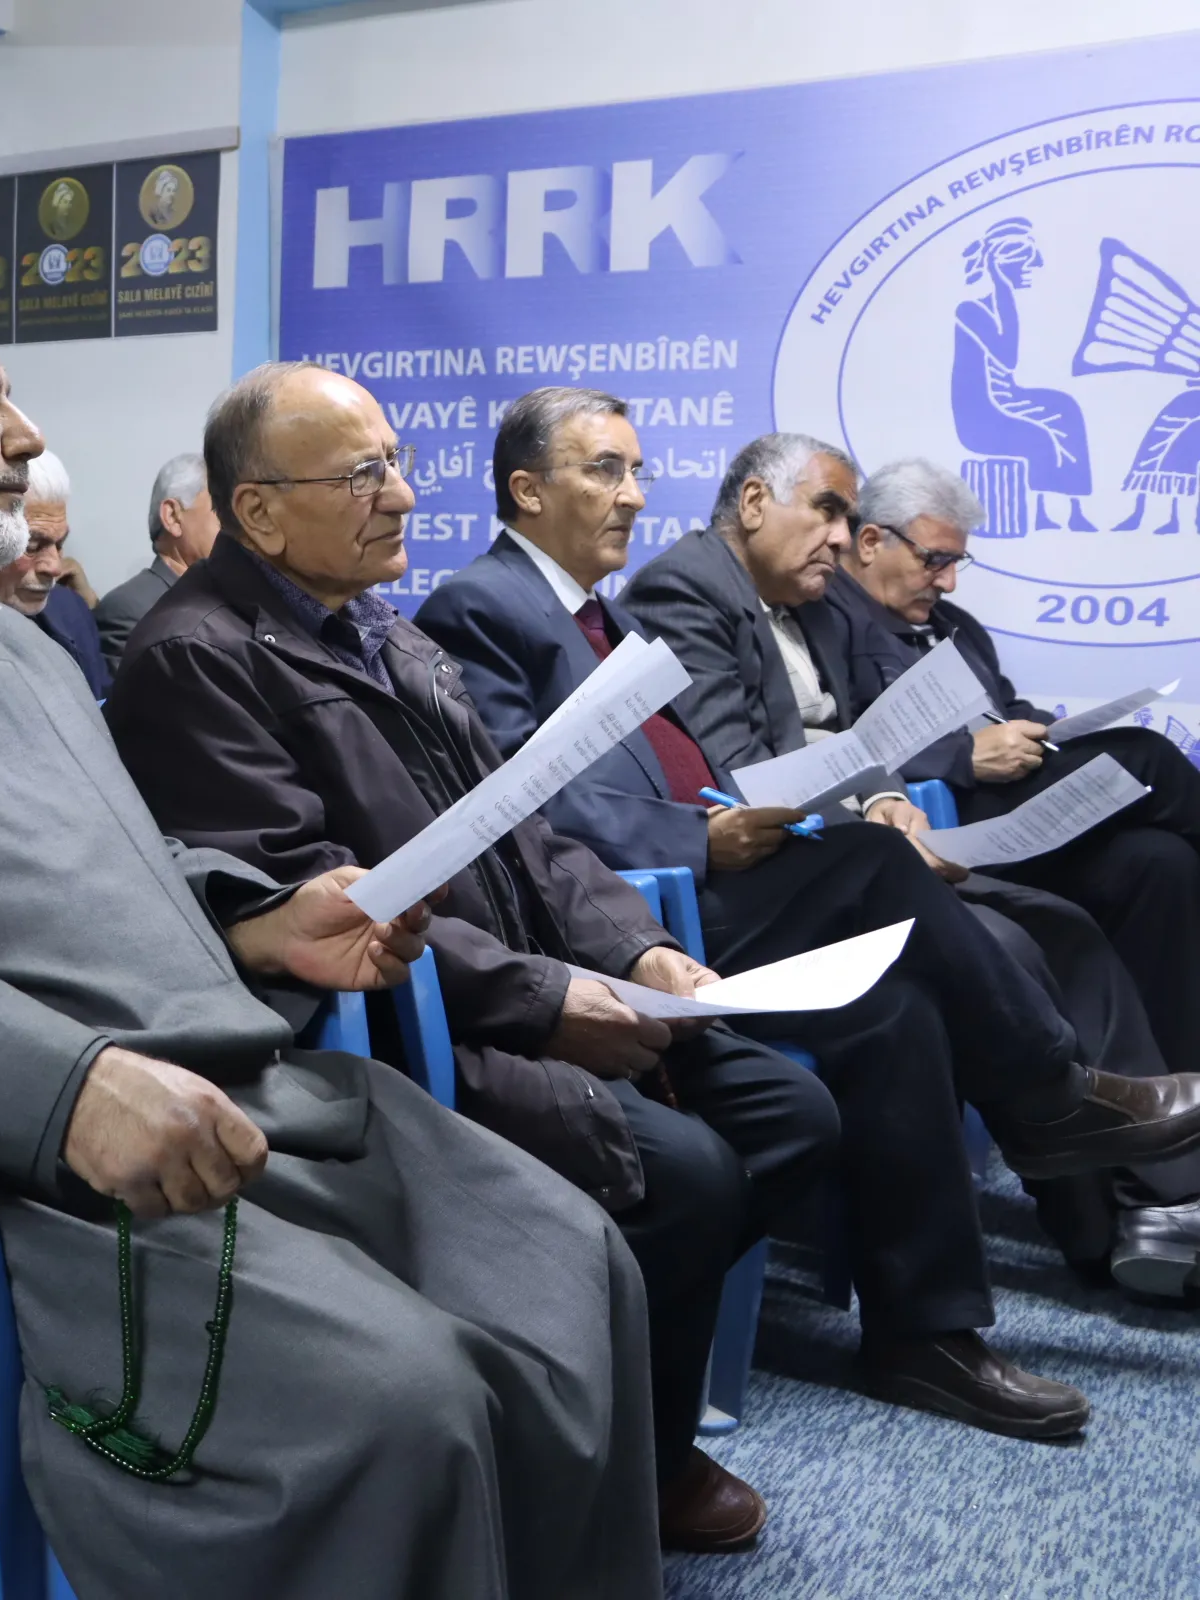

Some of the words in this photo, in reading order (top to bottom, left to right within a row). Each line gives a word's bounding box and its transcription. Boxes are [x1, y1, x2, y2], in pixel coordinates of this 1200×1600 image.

[312, 154, 740, 290] HRRK
[811, 195, 945, 326] HEVGIRTINA
[947, 123, 1155, 200] REWŞENBÎRÊN
[118, 289, 141, 304] SALA
[495, 334, 739, 381] REWŞENBÎRÊN
[383, 396, 477, 430] VAYÊ
[401, 513, 479, 542] EST
[1035, 594, 1170, 627] 2004
